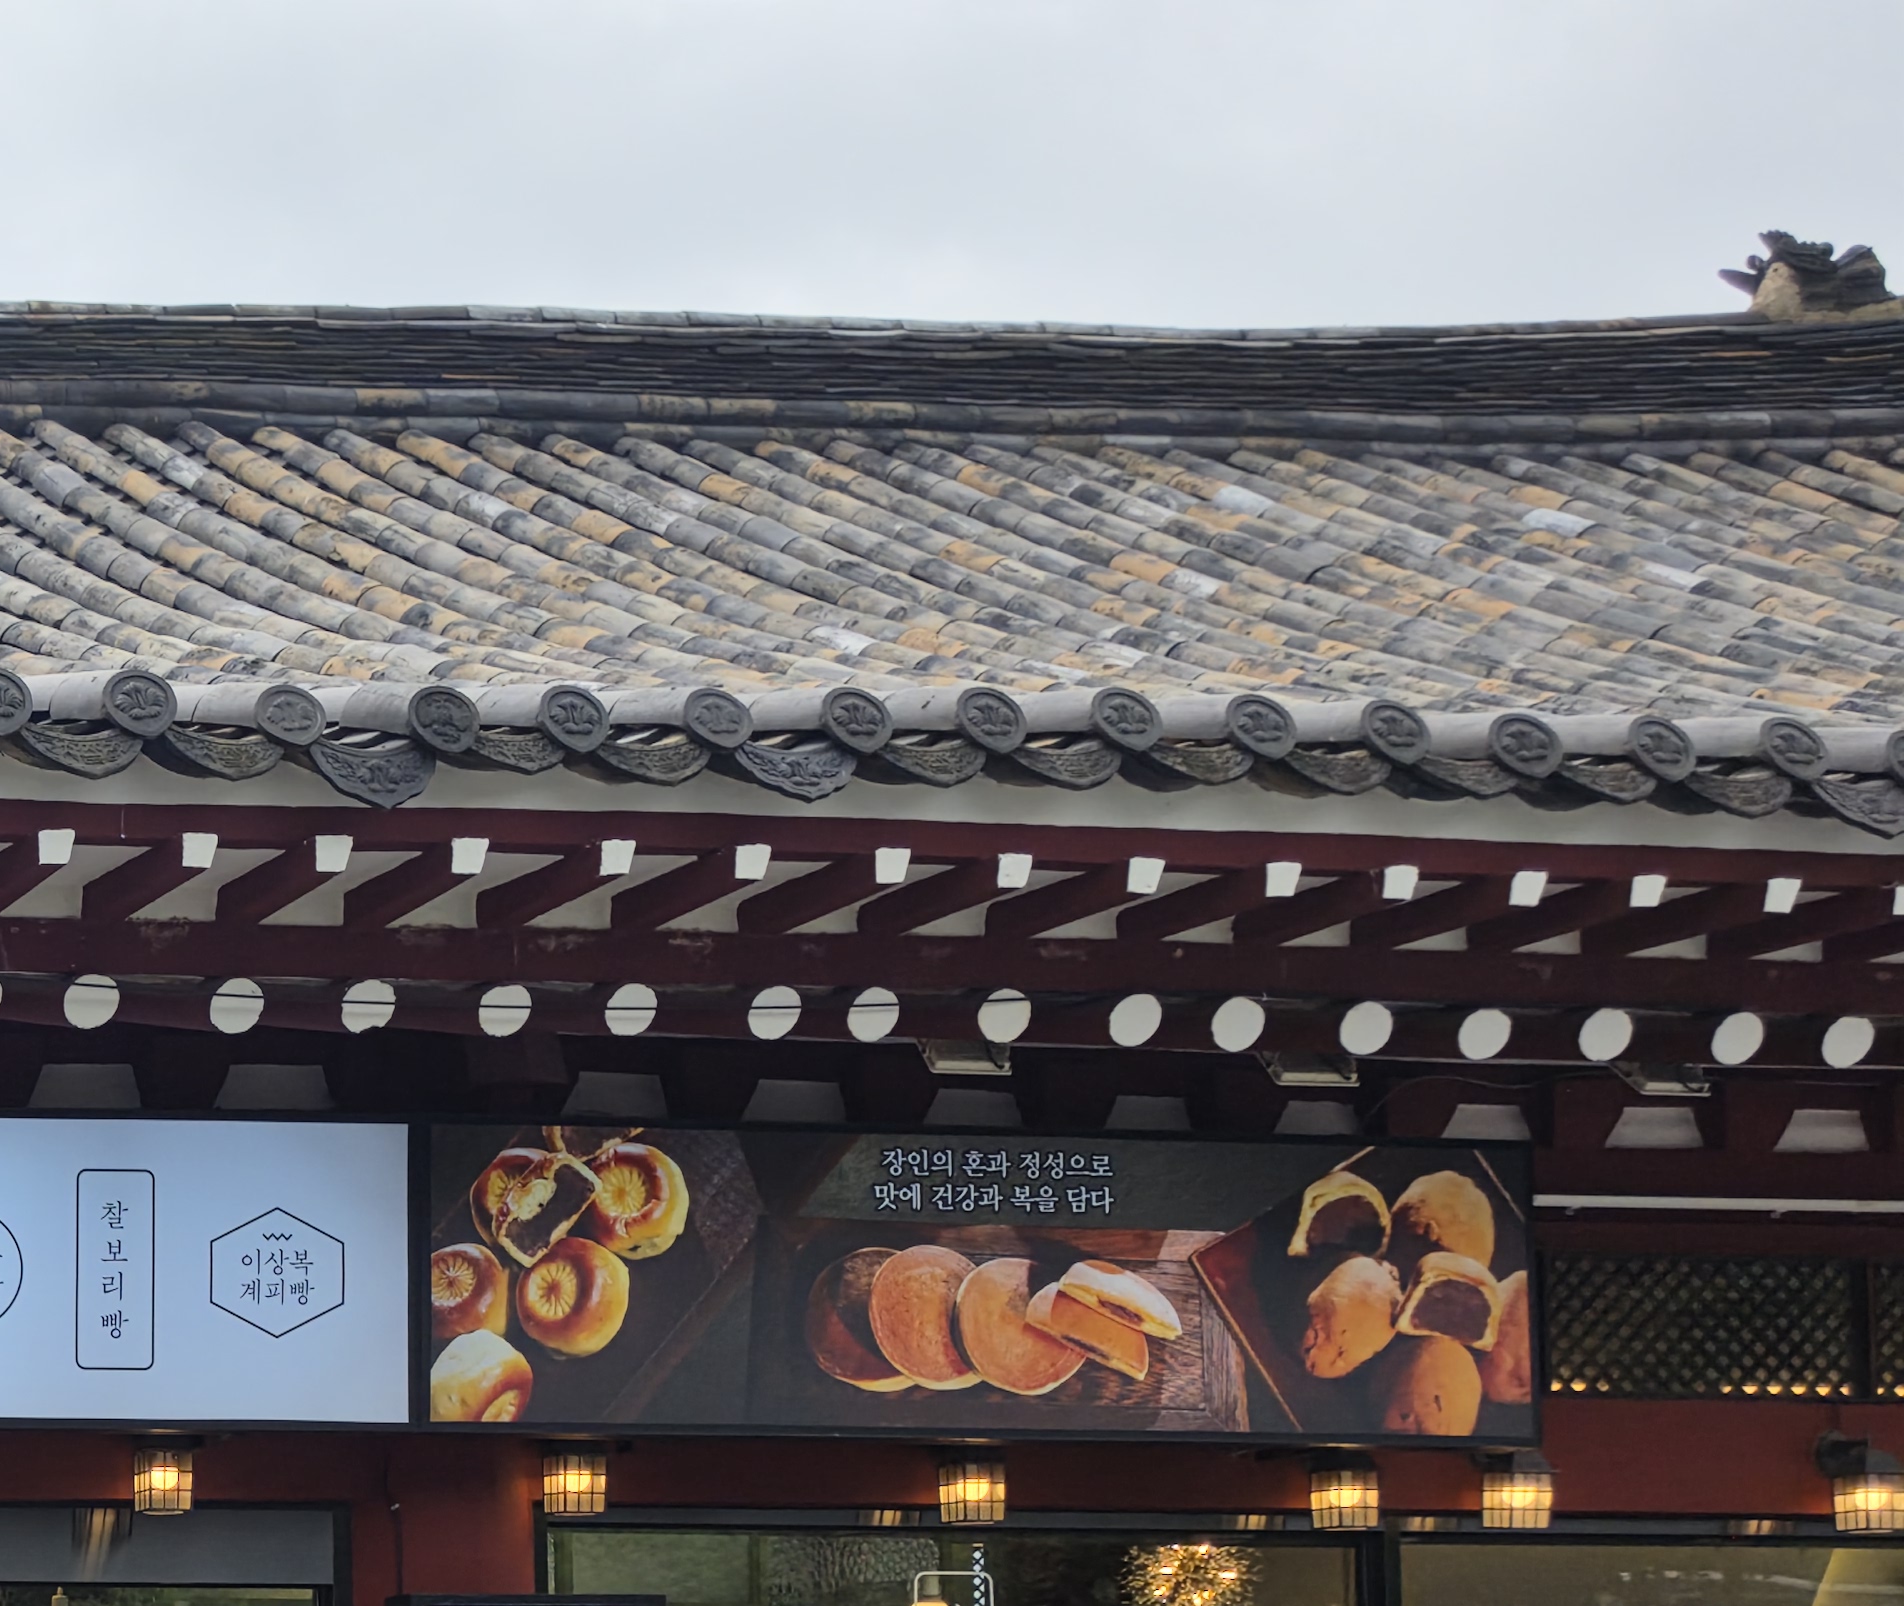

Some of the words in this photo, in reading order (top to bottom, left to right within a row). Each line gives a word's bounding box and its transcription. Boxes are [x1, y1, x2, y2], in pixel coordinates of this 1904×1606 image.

[882, 1149, 953, 1178] 장인의
[962, 1151, 1011, 1178] 혼과
[1019, 1152, 1113, 1180] 정성으로
[874, 1183, 921, 1211] 맛에
[932, 1184, 1003, 1212] 건강과
[1010, 1186, 1059, 1213] 복을
[1066, 1187, 1114, 1214] 담다
[100, 1200, 129, 1339] 찰보리빵
[242, 1248, 314, 1276] 이상복
[240, 1278, 315, 1305] 계피빵
